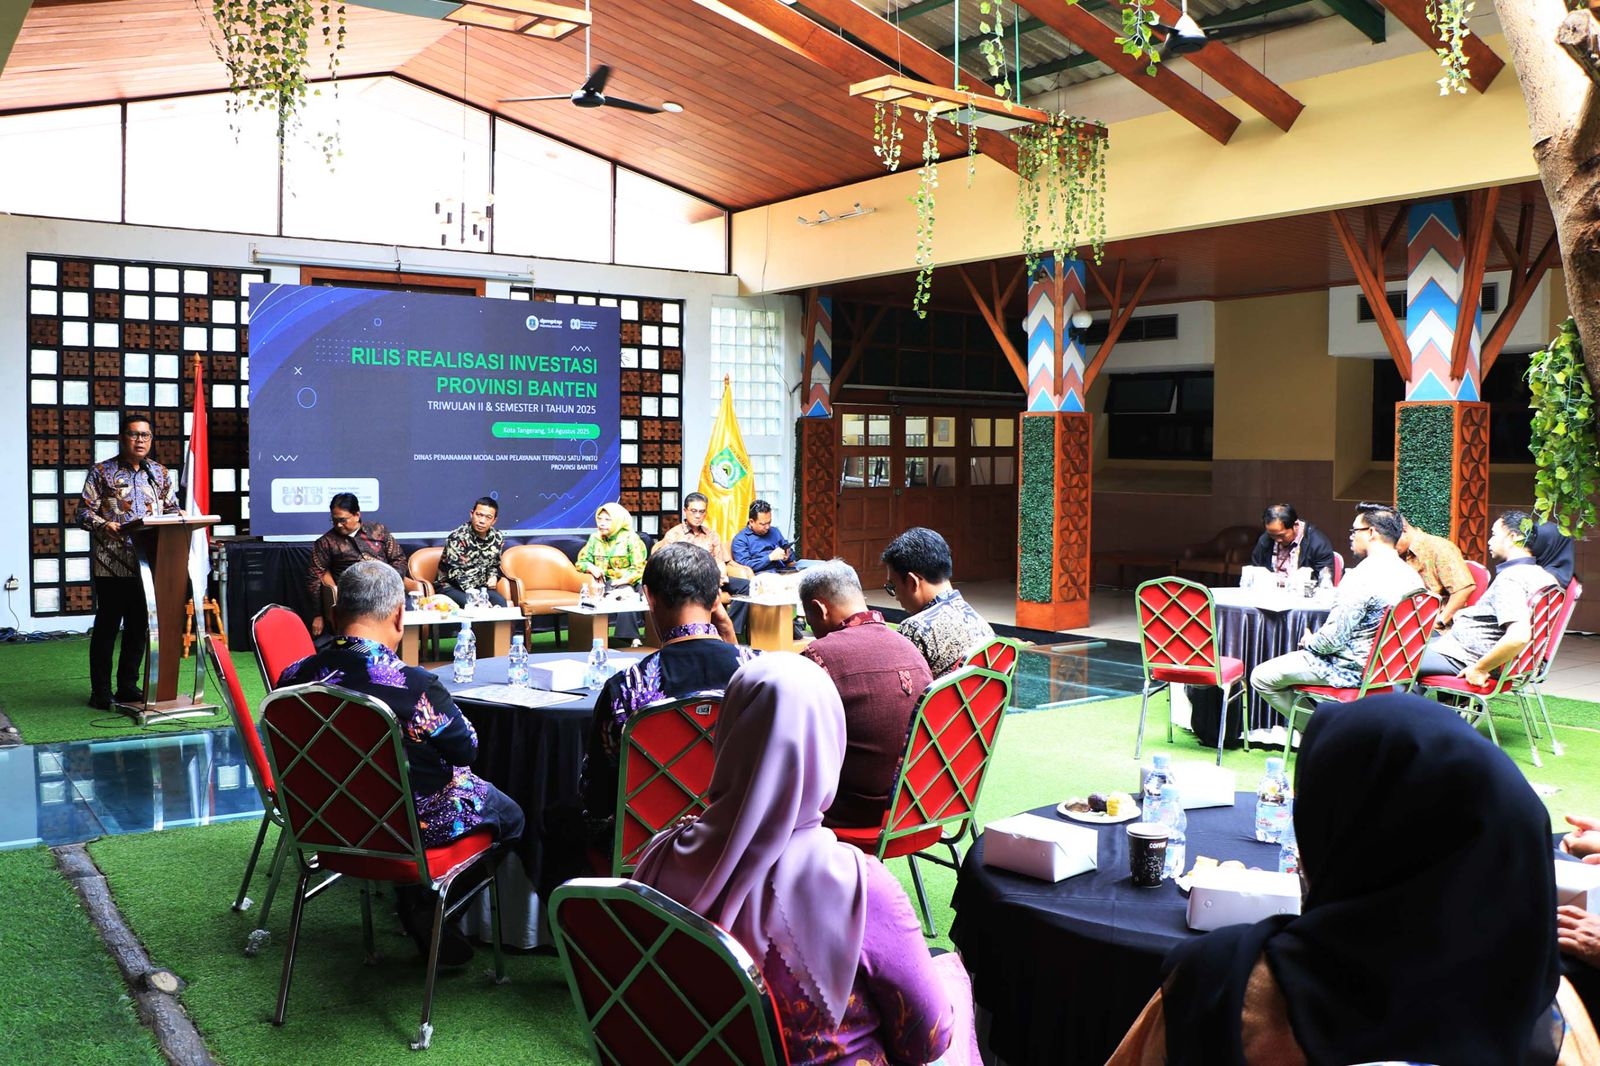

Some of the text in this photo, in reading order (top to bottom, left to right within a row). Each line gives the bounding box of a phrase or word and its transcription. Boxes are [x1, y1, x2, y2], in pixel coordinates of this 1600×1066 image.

[351, 347, 598, 374] RILIS REALISASI INVESTASI
[437, 376, 598, 398] PROVINSI BANTEN
[427, 400, 476, 412] TRIWULAN
[485, 402, 493, 412] &
[495, 402, 539, 413] SEMESTER
[545, 404, 574, 414] TAHUN
[576, 405, 597, 415] 2025
[517, 427, 546, 435] Tangerang,
